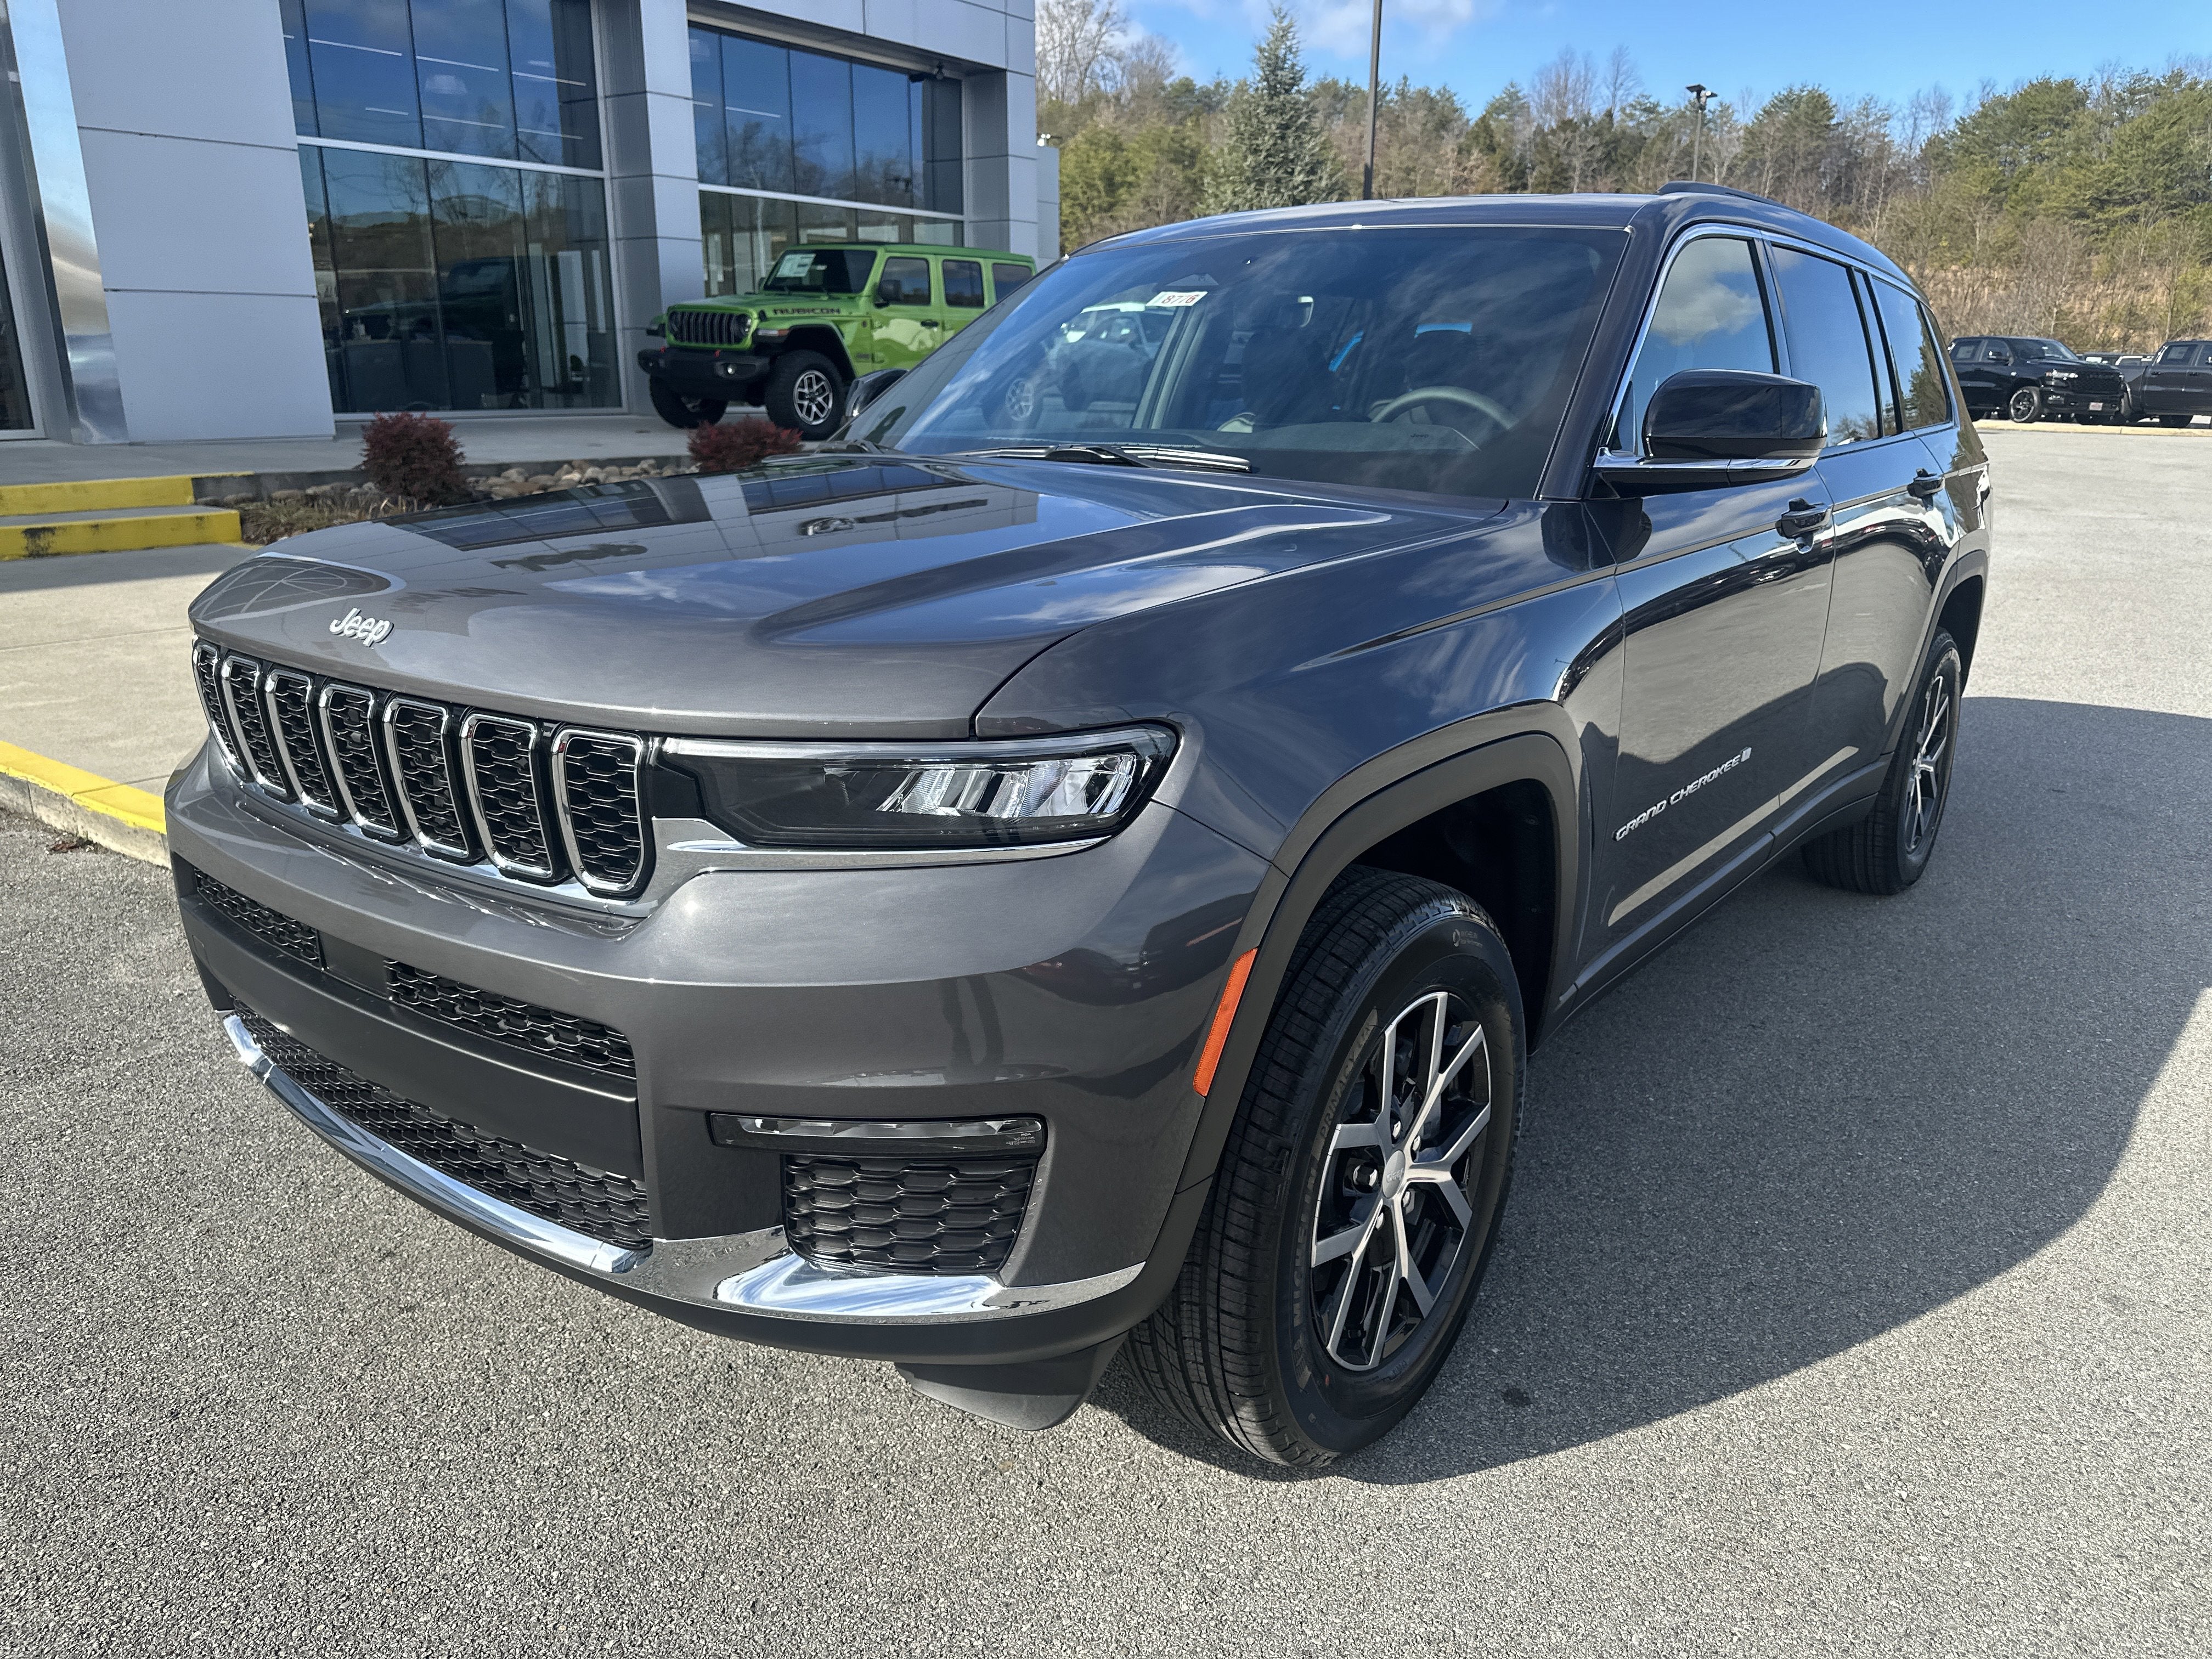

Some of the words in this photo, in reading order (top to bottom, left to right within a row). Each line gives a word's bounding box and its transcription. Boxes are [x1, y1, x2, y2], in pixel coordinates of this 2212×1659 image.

[1161, 294, 1200, 304] 8776
[329, 607, 394, 648] Jeep
[1615, 799, 1667, 842] GRAND
[1668, 754, 1741, 805] CHEROKEE
